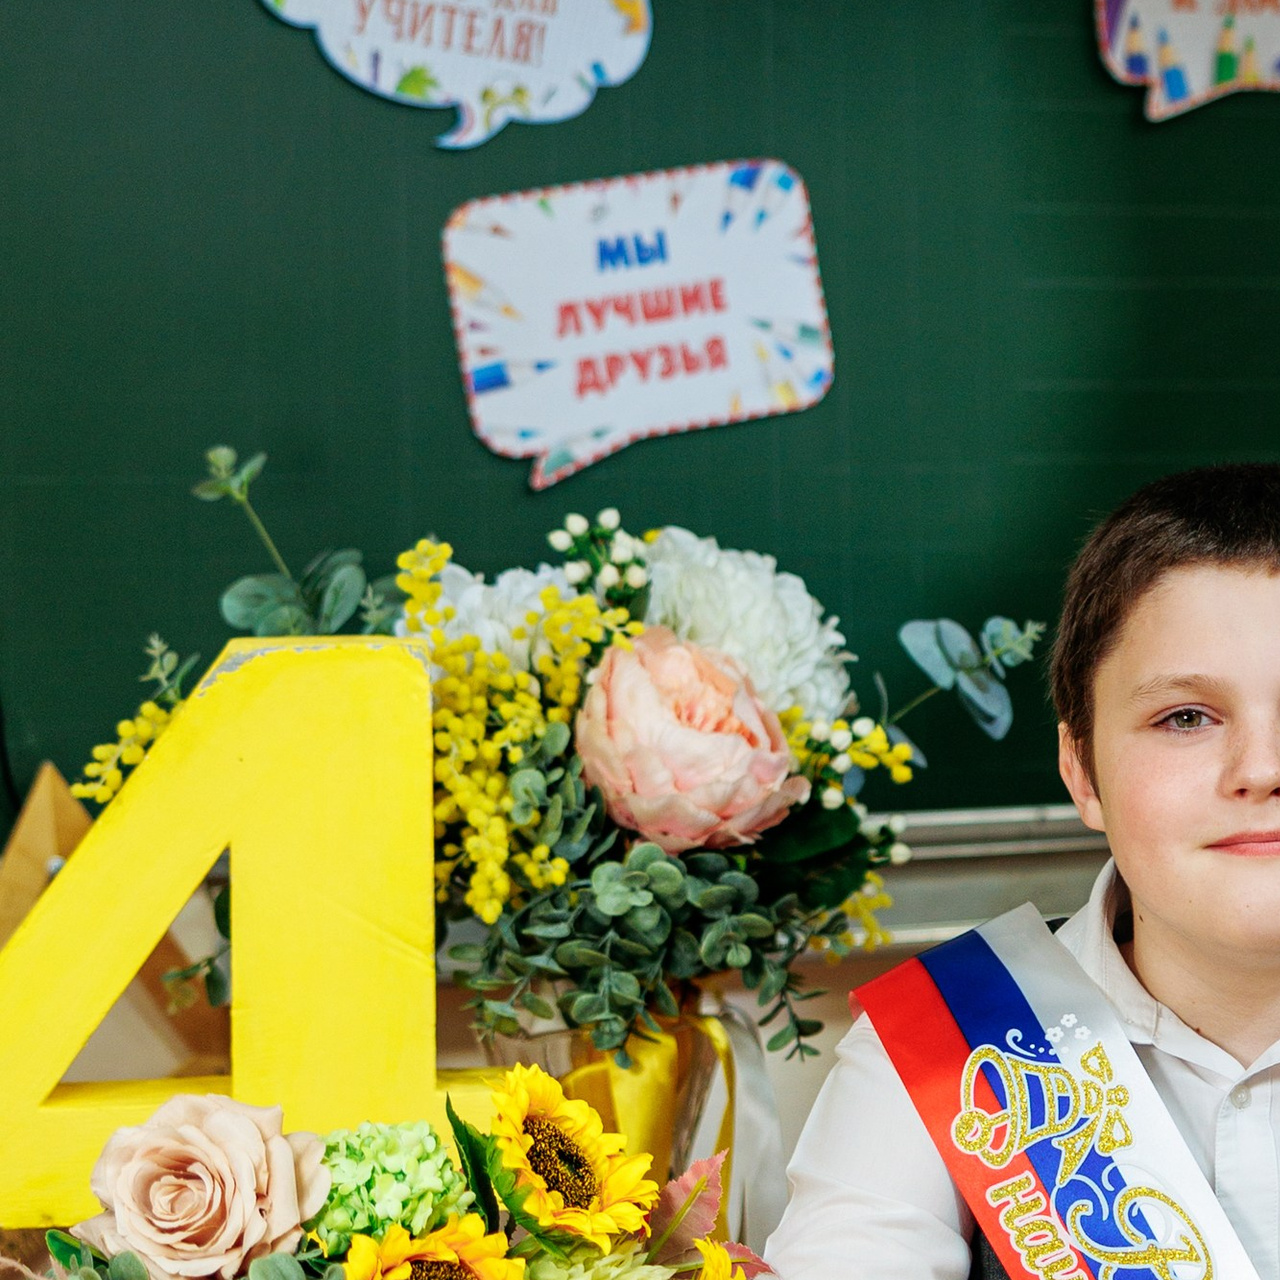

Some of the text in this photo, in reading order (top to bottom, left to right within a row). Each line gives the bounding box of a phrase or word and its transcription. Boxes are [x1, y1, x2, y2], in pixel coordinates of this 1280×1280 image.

[596, 229, 669, 272] МЫ
[557, 278, 726, 336] ЛУЧШИЕ
[575, 337, 726, 396] ДРУЗЬЯ
[0, 635, 500, 1230] 4
